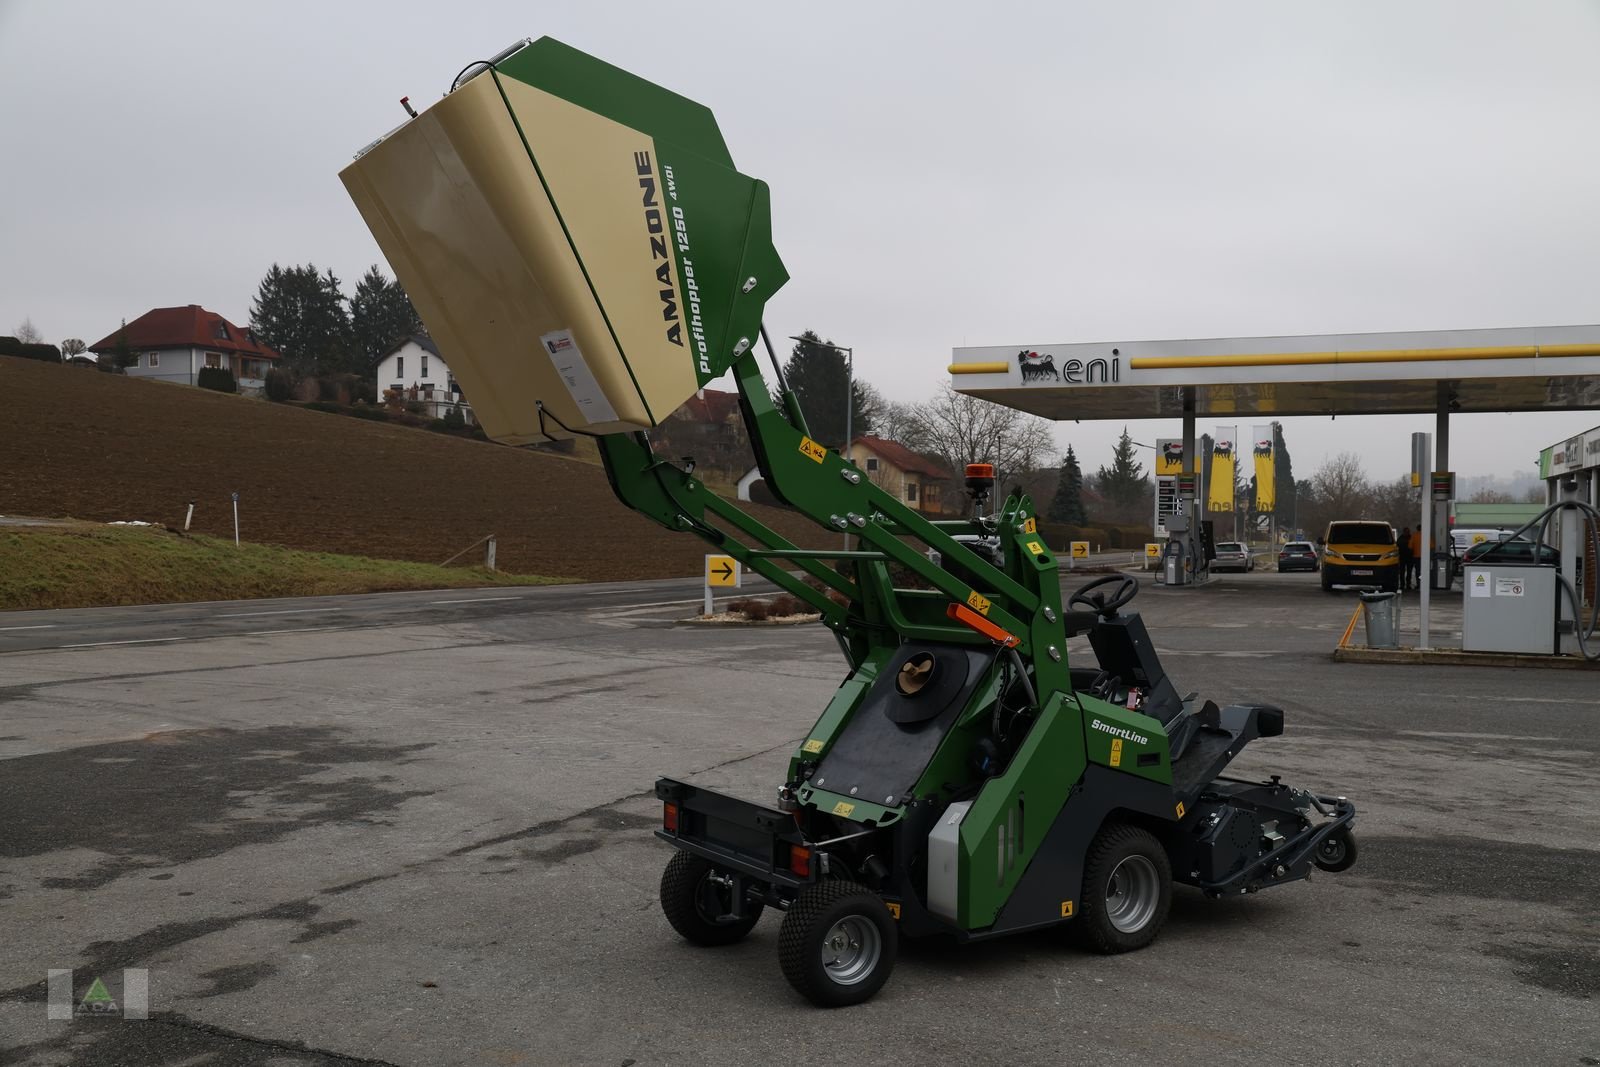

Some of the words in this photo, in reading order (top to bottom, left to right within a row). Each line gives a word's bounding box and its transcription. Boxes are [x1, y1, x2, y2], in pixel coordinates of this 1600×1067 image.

[634, 151, 684, 347] AMAZONE
[672, 206, 689, 252] 1250
[683, 257, 711, 374] Profihopper
[1063, 348, 1121, 384] eni
[1091, 719, 1148, 745] SmartLine
